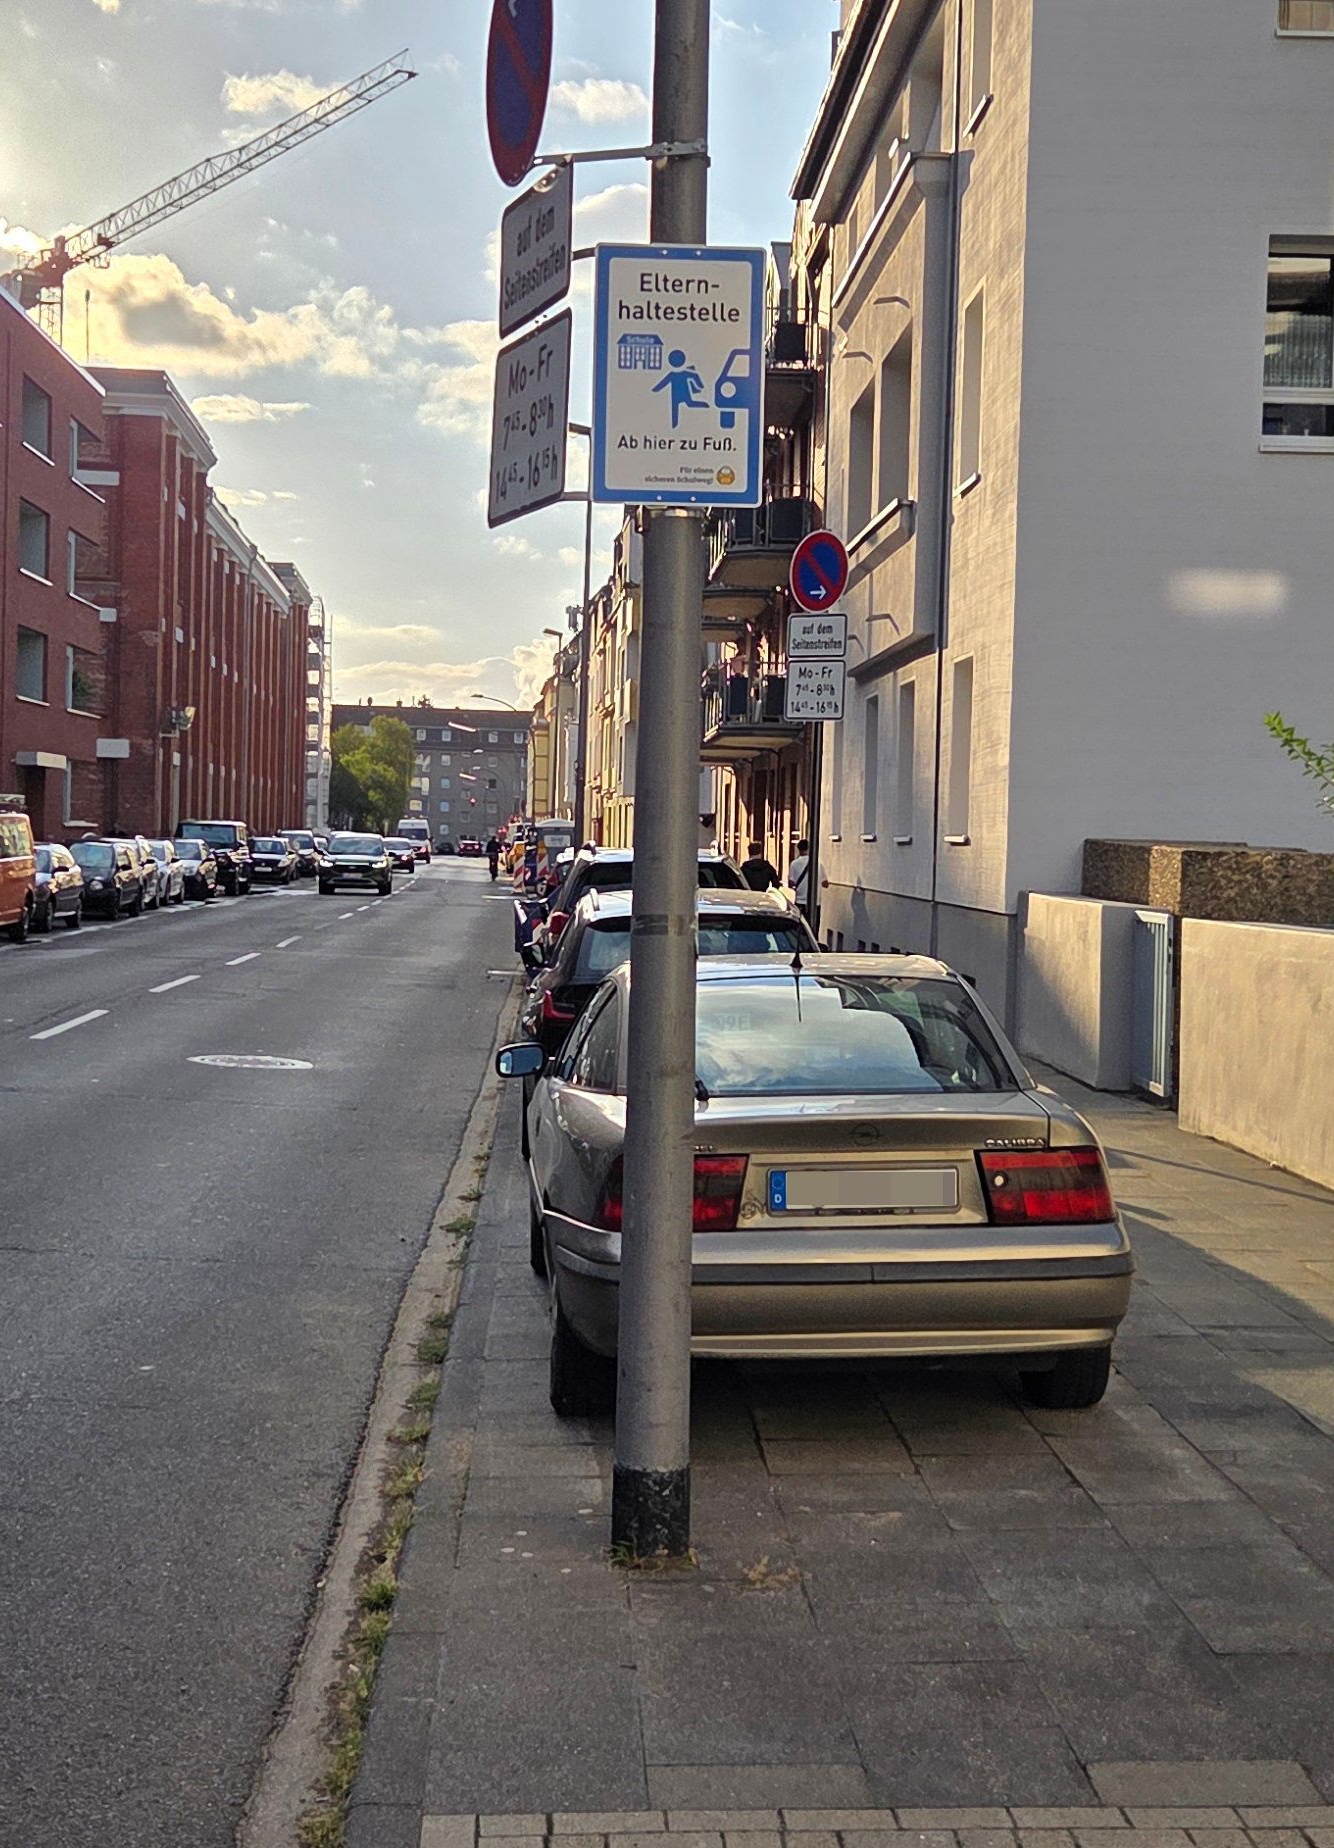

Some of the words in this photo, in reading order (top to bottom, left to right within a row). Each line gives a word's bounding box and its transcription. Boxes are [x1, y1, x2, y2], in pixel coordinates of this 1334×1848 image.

[517, 215, 532, 257] auf
[535, 206, 555, 243] dem
[504, 242, 566, 311] Seitenstreifen
[640, 273, 720, 294] Eltern-
[618, 299, 740, 322] haltestelle
[617, 435, 638, 449] Ab
[643, 435, 675, 450] hier
[679, 439, 697, 450] zu
[703, 437, 737, 451] Fuß.
[802, 623, 814, 635] auf
[817, 622, 833, 635] dem
[791, 638, 842, 650] Seitenstreifen
[774, 1193, 783, 1204] D
